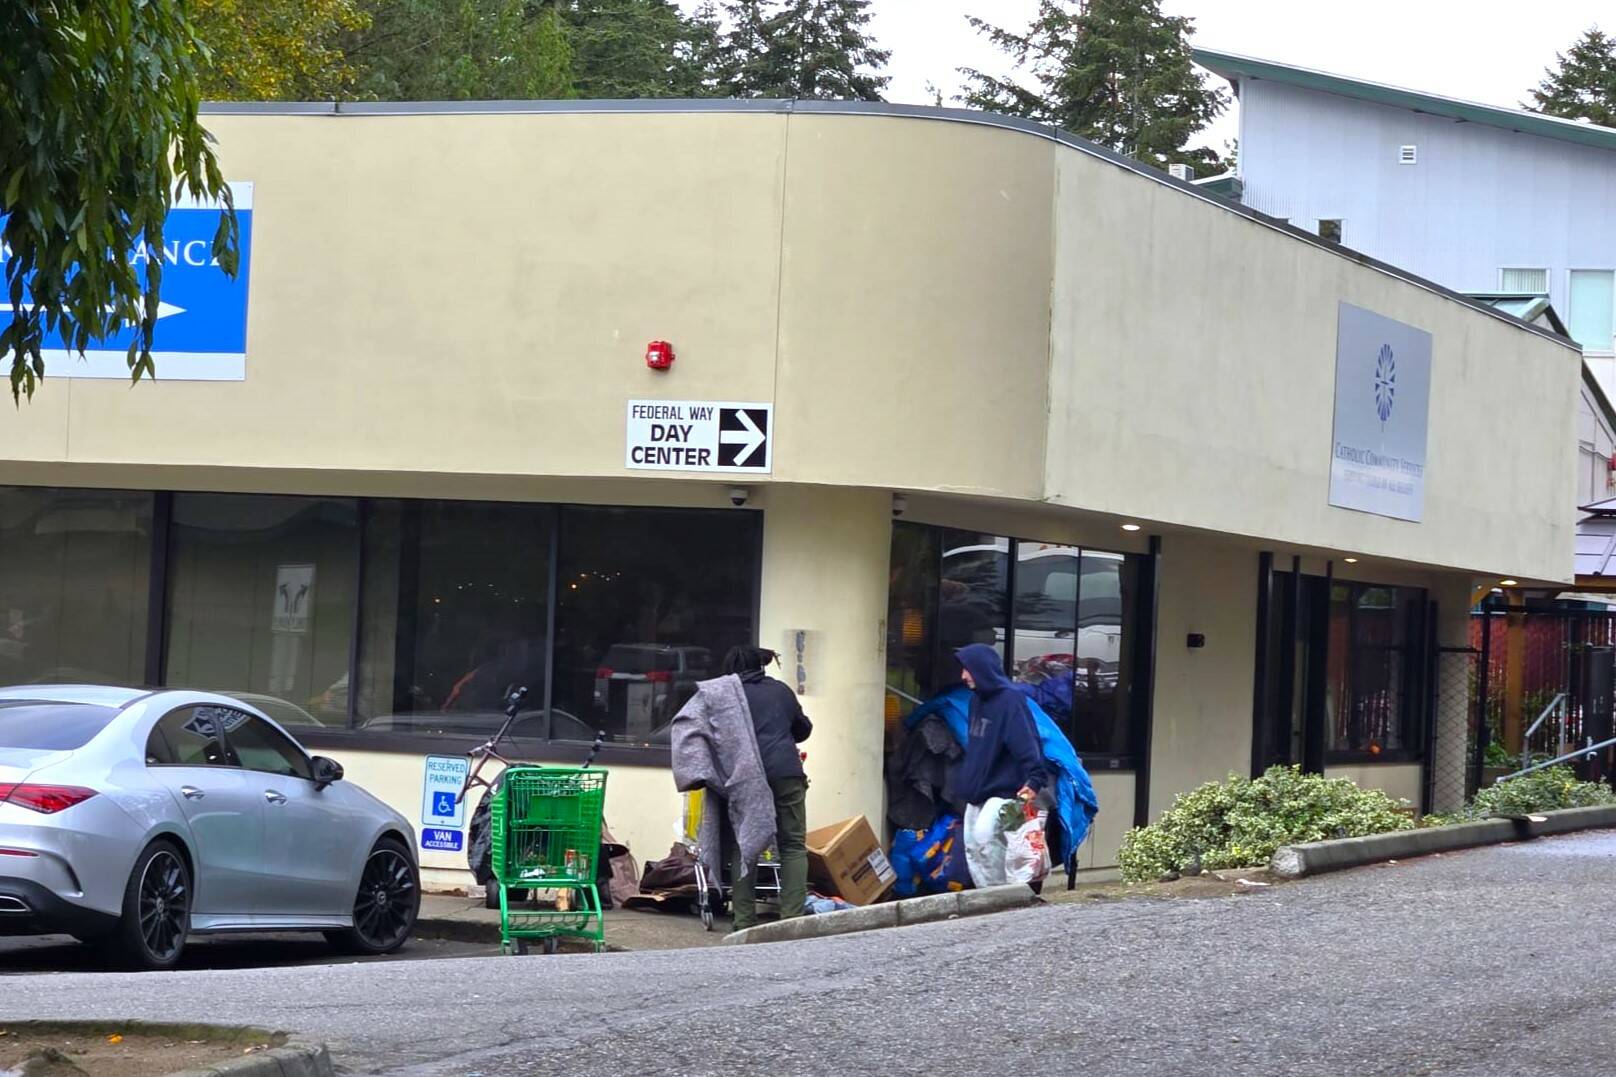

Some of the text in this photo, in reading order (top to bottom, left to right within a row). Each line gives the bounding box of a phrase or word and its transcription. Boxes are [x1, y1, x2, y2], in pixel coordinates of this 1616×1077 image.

[632, 405, 714, 421] FEDERAL WAY
[650, 424, 693, 442] DAY
[631, 446, 711, 466] CENTER
[428, 761, 465, 773] RESERVED
[429, 773, 462, 785] PARKING
[434, 831, 452, 841] VAN
